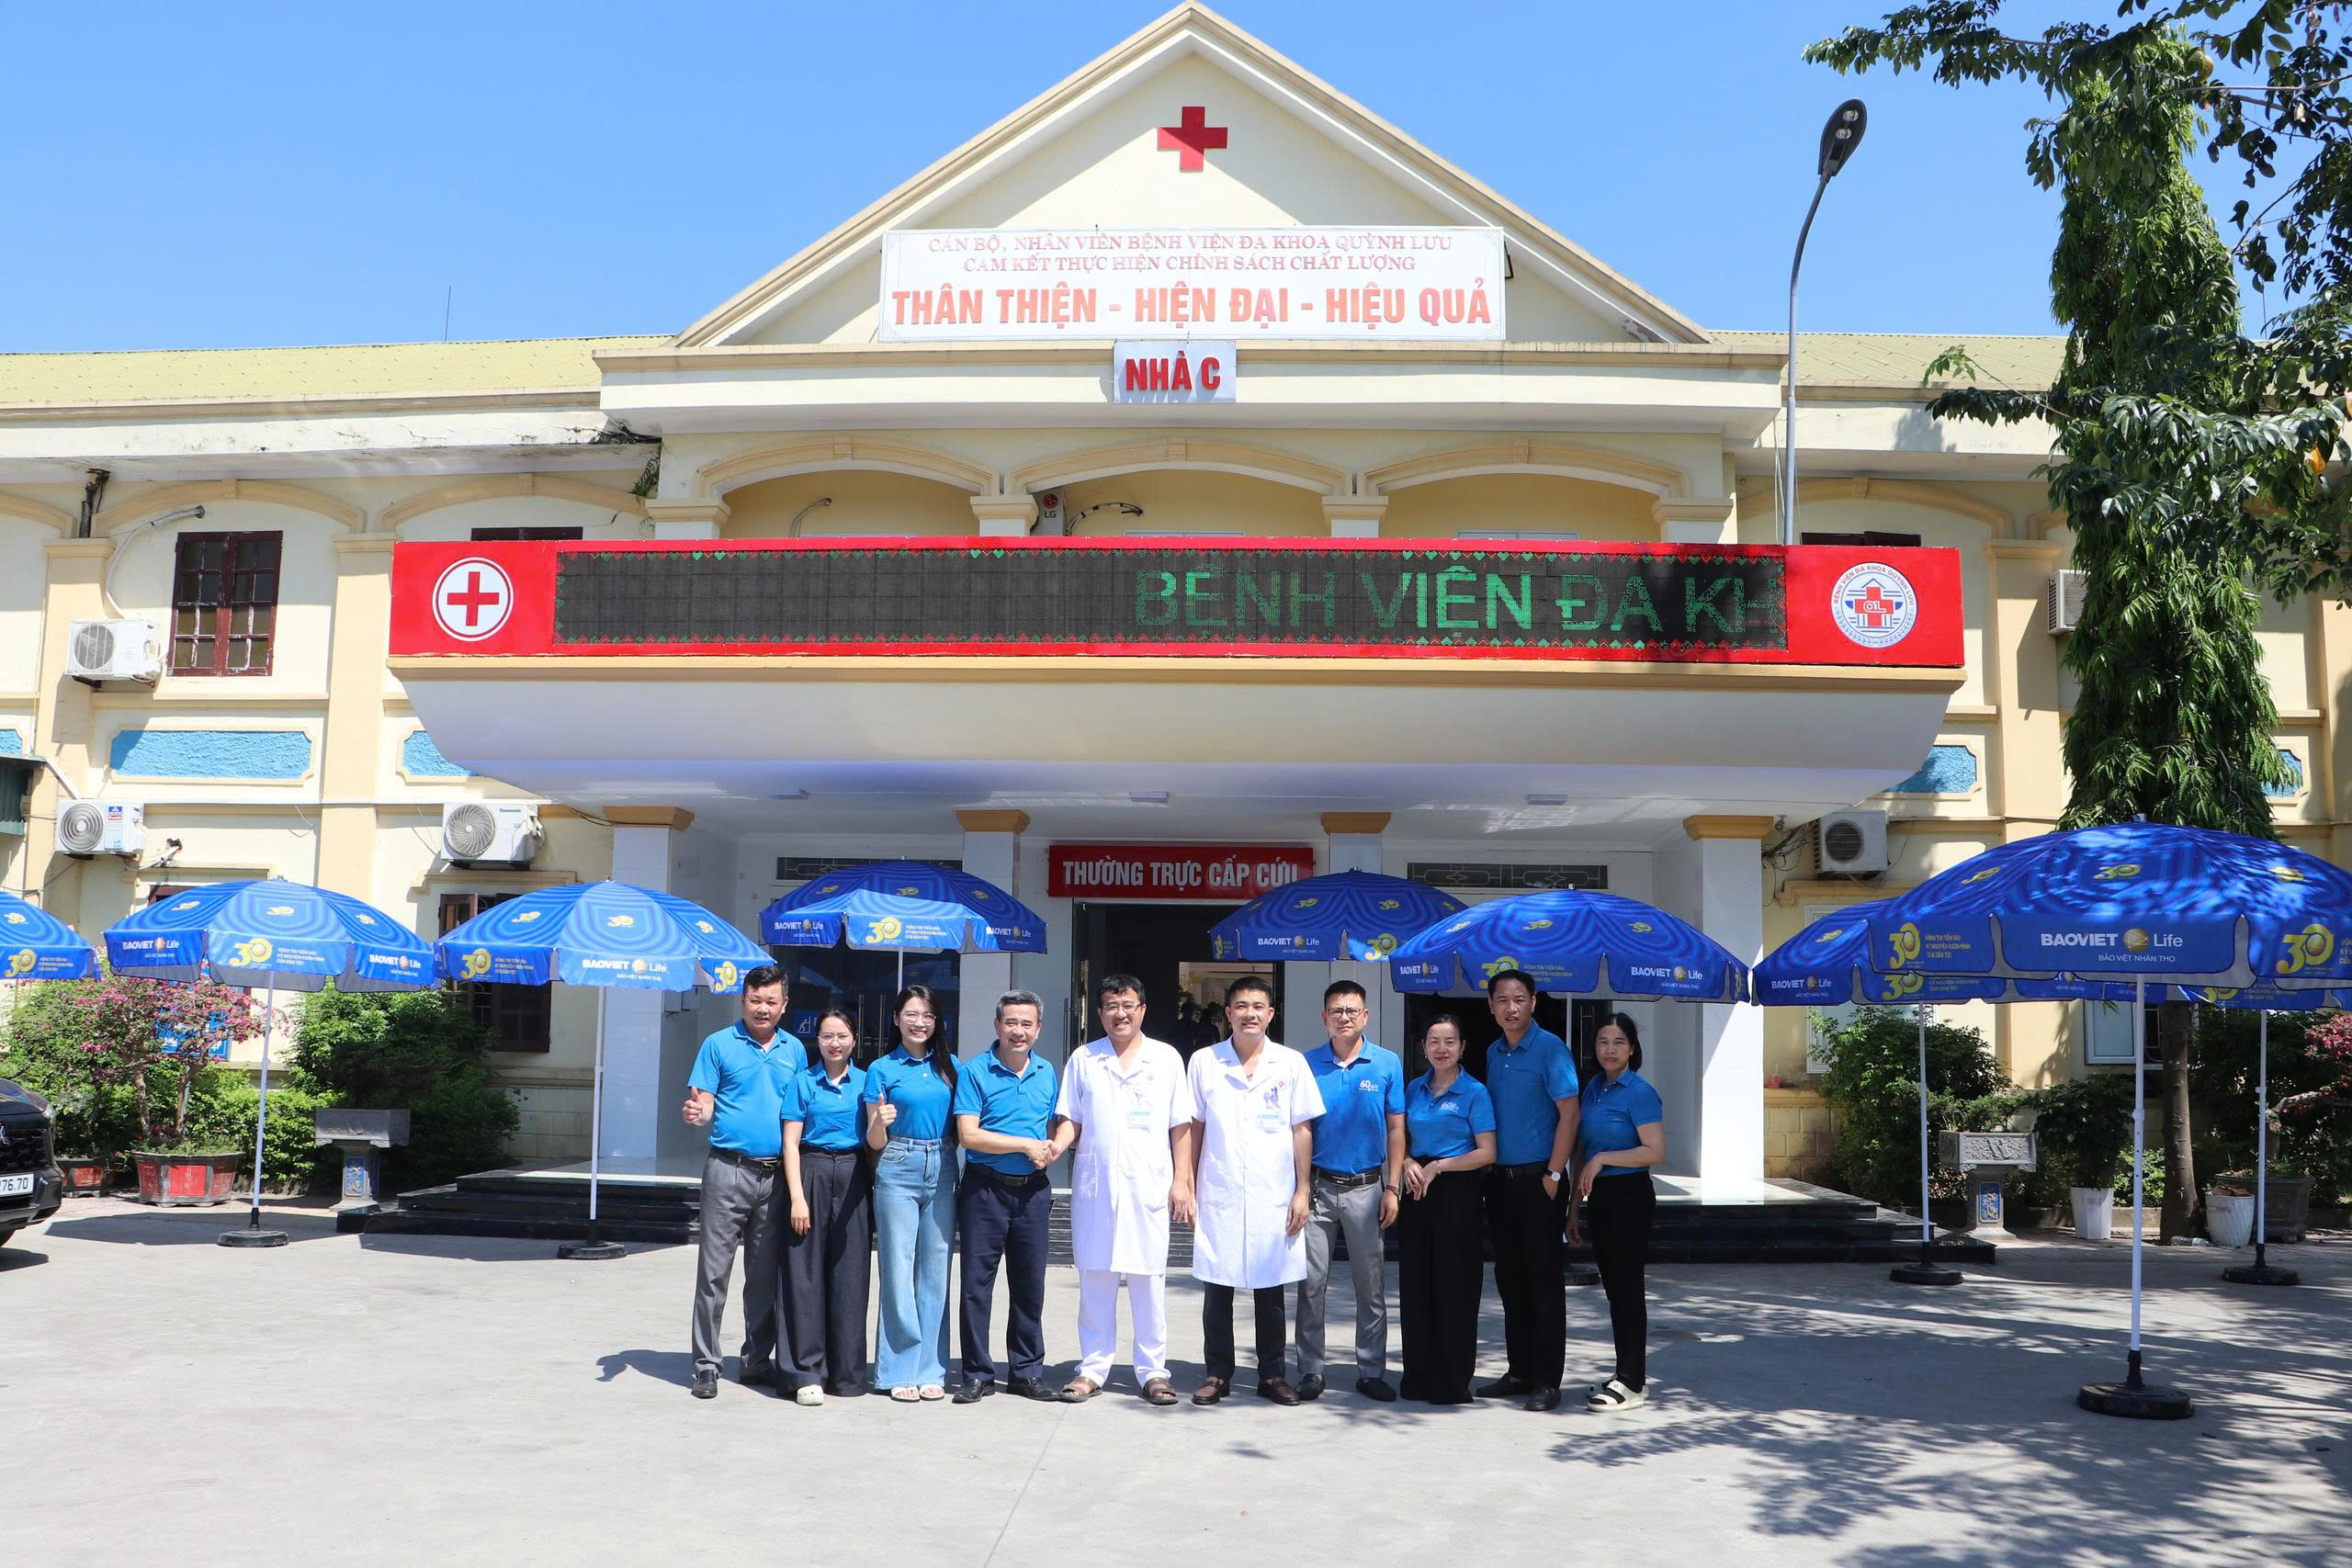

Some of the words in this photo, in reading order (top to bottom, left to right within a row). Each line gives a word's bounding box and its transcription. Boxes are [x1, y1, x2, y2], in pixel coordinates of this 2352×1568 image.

[1014, 233, 1069, 251] NHÂN
[1074, 232, 1123, 250] VIÊN
[1127, 232, 1182, 252] BỆNH
[1188, 232, 1234, 253] VIỆN
[1239, 234, 1267, 250] ĐA
[1272, 234, 1331, 250] KHOA
[1411, 234, 1453, 251] LƯU
[964, 256, 1007, 273] CAM
[1012, 252, 1051, 272] KẾT
[1056, 254, 1108, 274] THỰC
[1113, 253, 1160, 274] HIỆN
[1165, 252, 1230, 270] CHÍNH
[1233, 252, 1286, 271] SÁCH
[1289, 250, 1342, 271] CHẤT
[1348, 254, 1417, 273] LƯỢNG
[892, 282, 983, 325] THÂN
[996, 280, 1097, 329] THIỆN
[1135, 280, 1216, 329] HIỆN
[1229, 288, 1288, 329] ĐẠI
[1326, 281, 1406, 330] HIỆU
[1419, 277, 1491, 326] QUẢ
[1125, 350, 1193, 390] NHÀ
[1201, 356, 1221, 390] C
[1044, 511, 1057, 519] LG
[1359, 564, 1532, 637] VIỆN
[1555, 573, 1664, 633] ĐA
[1063, 854, 1144, 886] THƯỜNG
[1149, 859, 1202, 892] TRỰC
[1208, 853, 1250, 887] CẤP
[865, 917, 902, 943] 30
[1258, 937, 1292, 946] BAOVIET
[1306, 937, 1320, 946] Life
[2041, 933, 2119, 947] BAOVIET
[2154, 933, 2184, 947] Life
[121, 941, 153, 951] BAOVIET
[229, 938, 274, 966] 30
[1364, 933, 1397, 961] 30
[1889, 922, 1921, 969] 30
[2098, 953, 2115, 962] BẢO
[2116, 953, 2132, 962] VIỆT
[2134, 953, 2157, 962] NHÂN
[2159, 954, 2176, 963] THỌ
[2277, 923, 2335, 975] 30
[5, 948, 38, 978] 30
[460, 948, 492, 979] 30
[582, 959, 630, 970] BAOVIET
[650, 963, 667, 973] Life
[1631, 966, 1671, 977] BAOVIET
[1689, 969, 1703, 980] Life
[714, 961, 738, 992] 30
[1771, 979, 1804, 989] BAOVIET
[1818, 978, 1832, 987] Life
[1360, 1080, 1371, 1089] 60
[0, 1177, 28, 1191] 76.70
